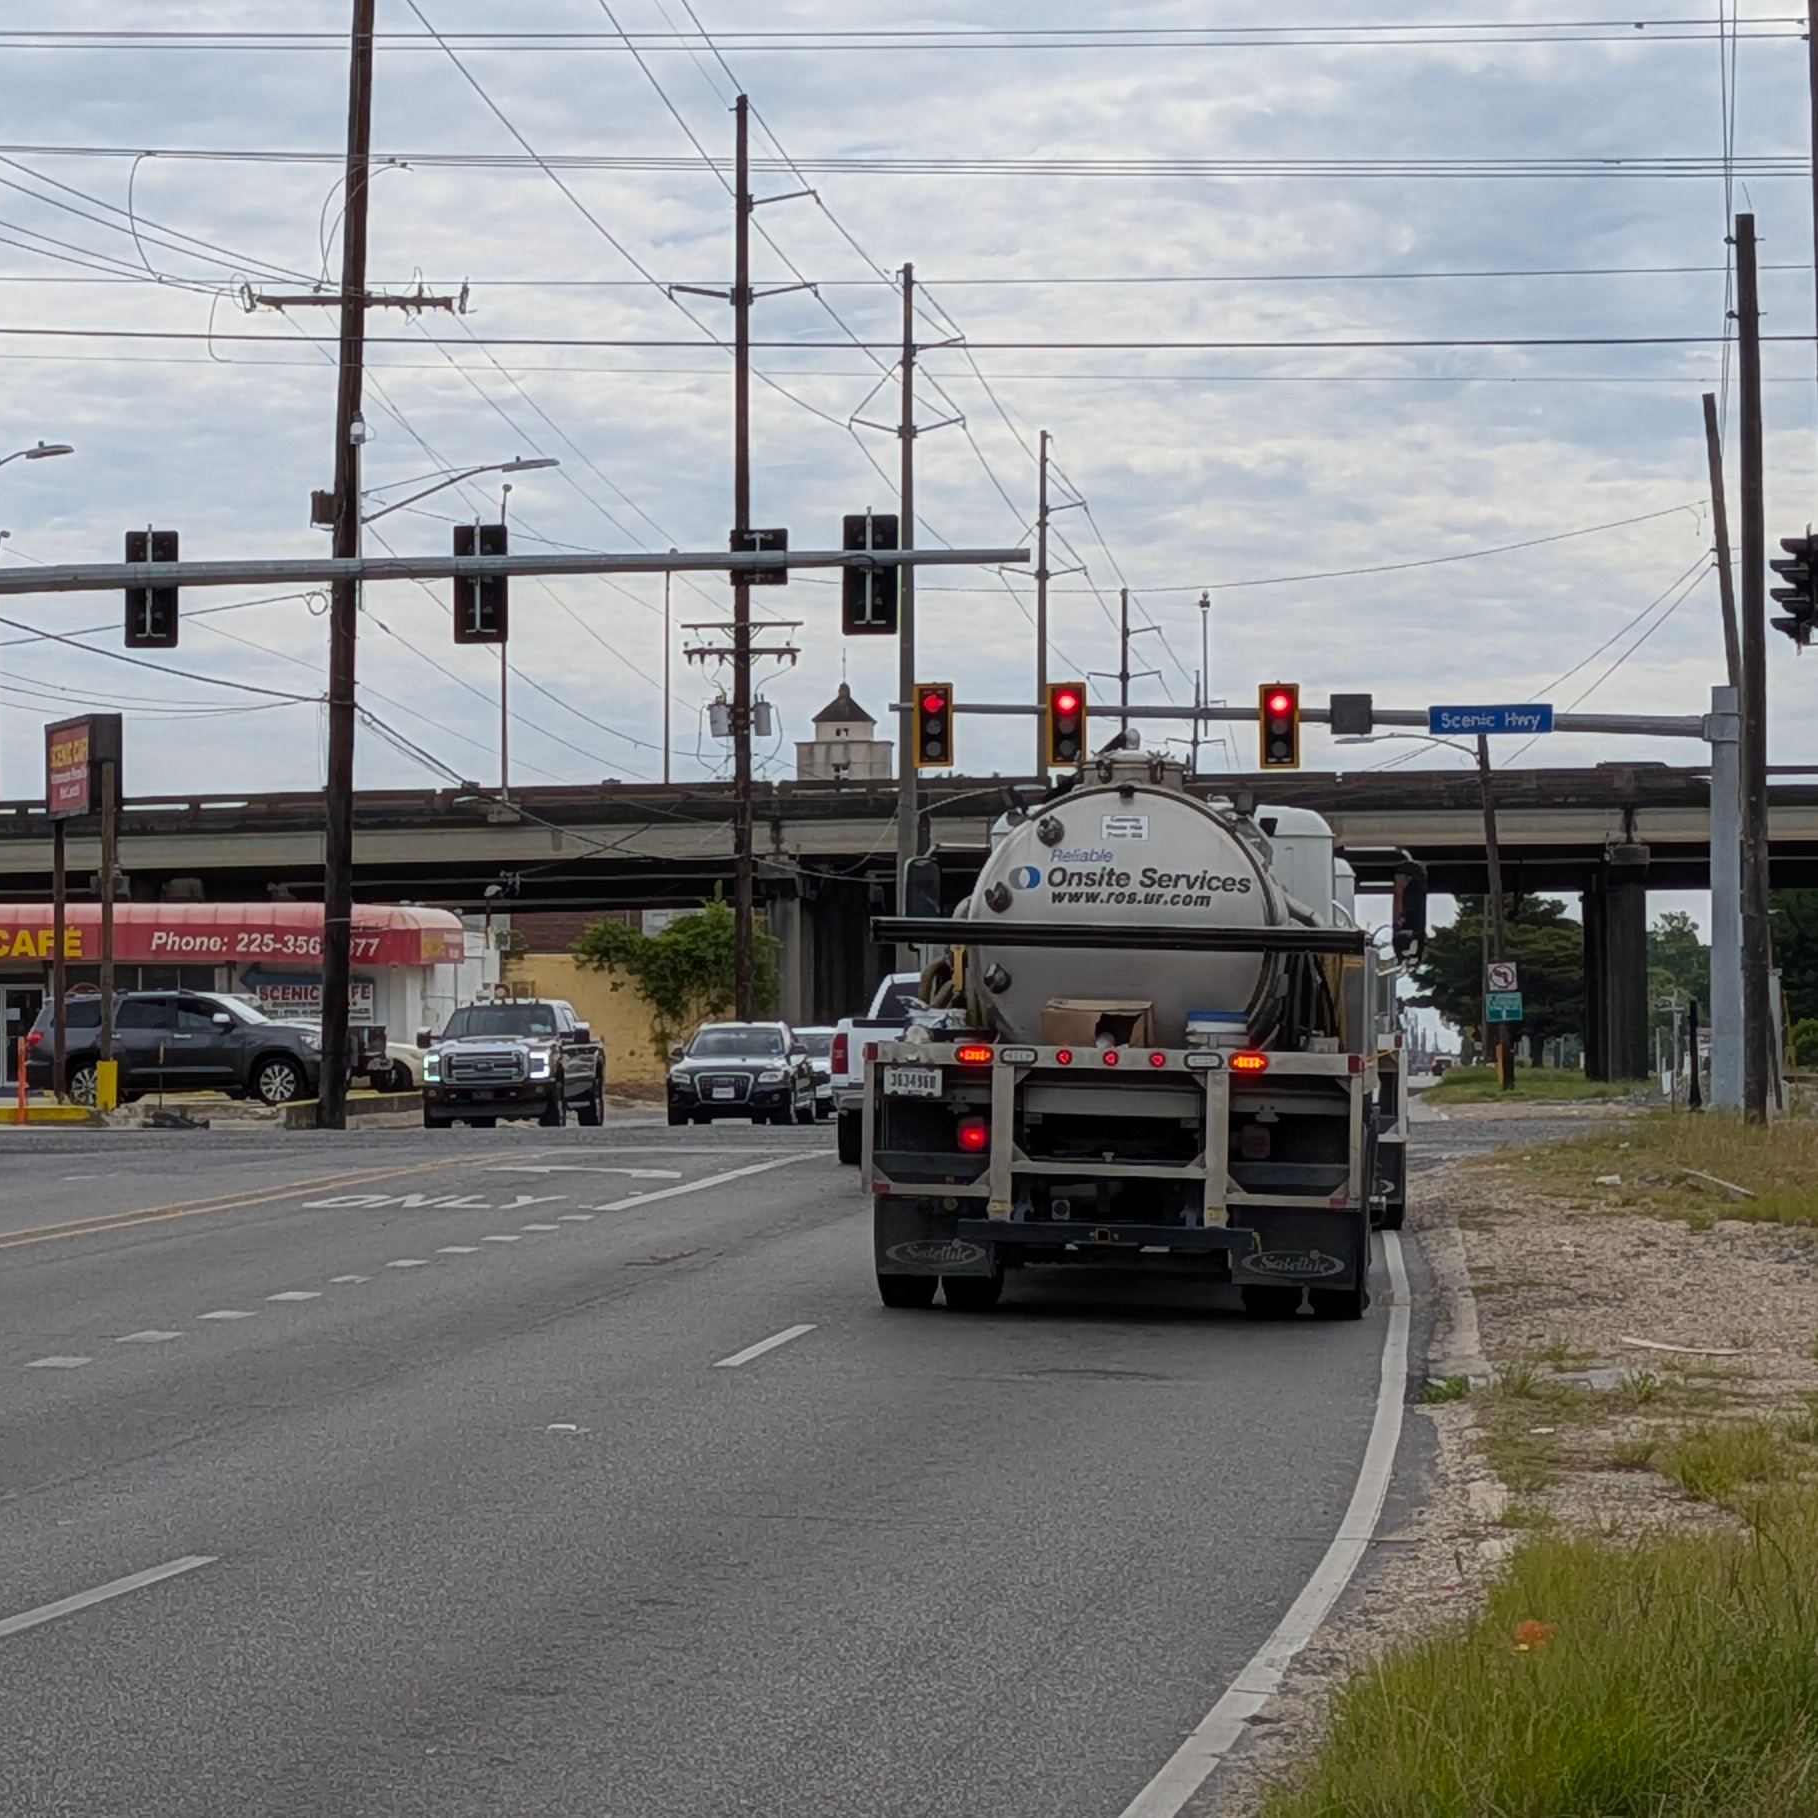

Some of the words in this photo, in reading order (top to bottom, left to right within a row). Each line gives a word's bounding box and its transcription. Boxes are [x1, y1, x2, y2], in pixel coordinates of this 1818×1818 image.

[1440, 712, 1496, 729] Scenic
[1504, 711, 1541, 731] Hwy
[1050, 848, 1114, 862] Reliable
[1047, 866, 1131, 888] Onsite
[1138, 867, 1251, 893] Services
[1051, 890, 1212, 907] www.ros.ur.com
[151, 931, 229, 952] Phone:
[259, 985, 320, 1001] SCENIC
[301, 1193, 568, 1209] ONLY
